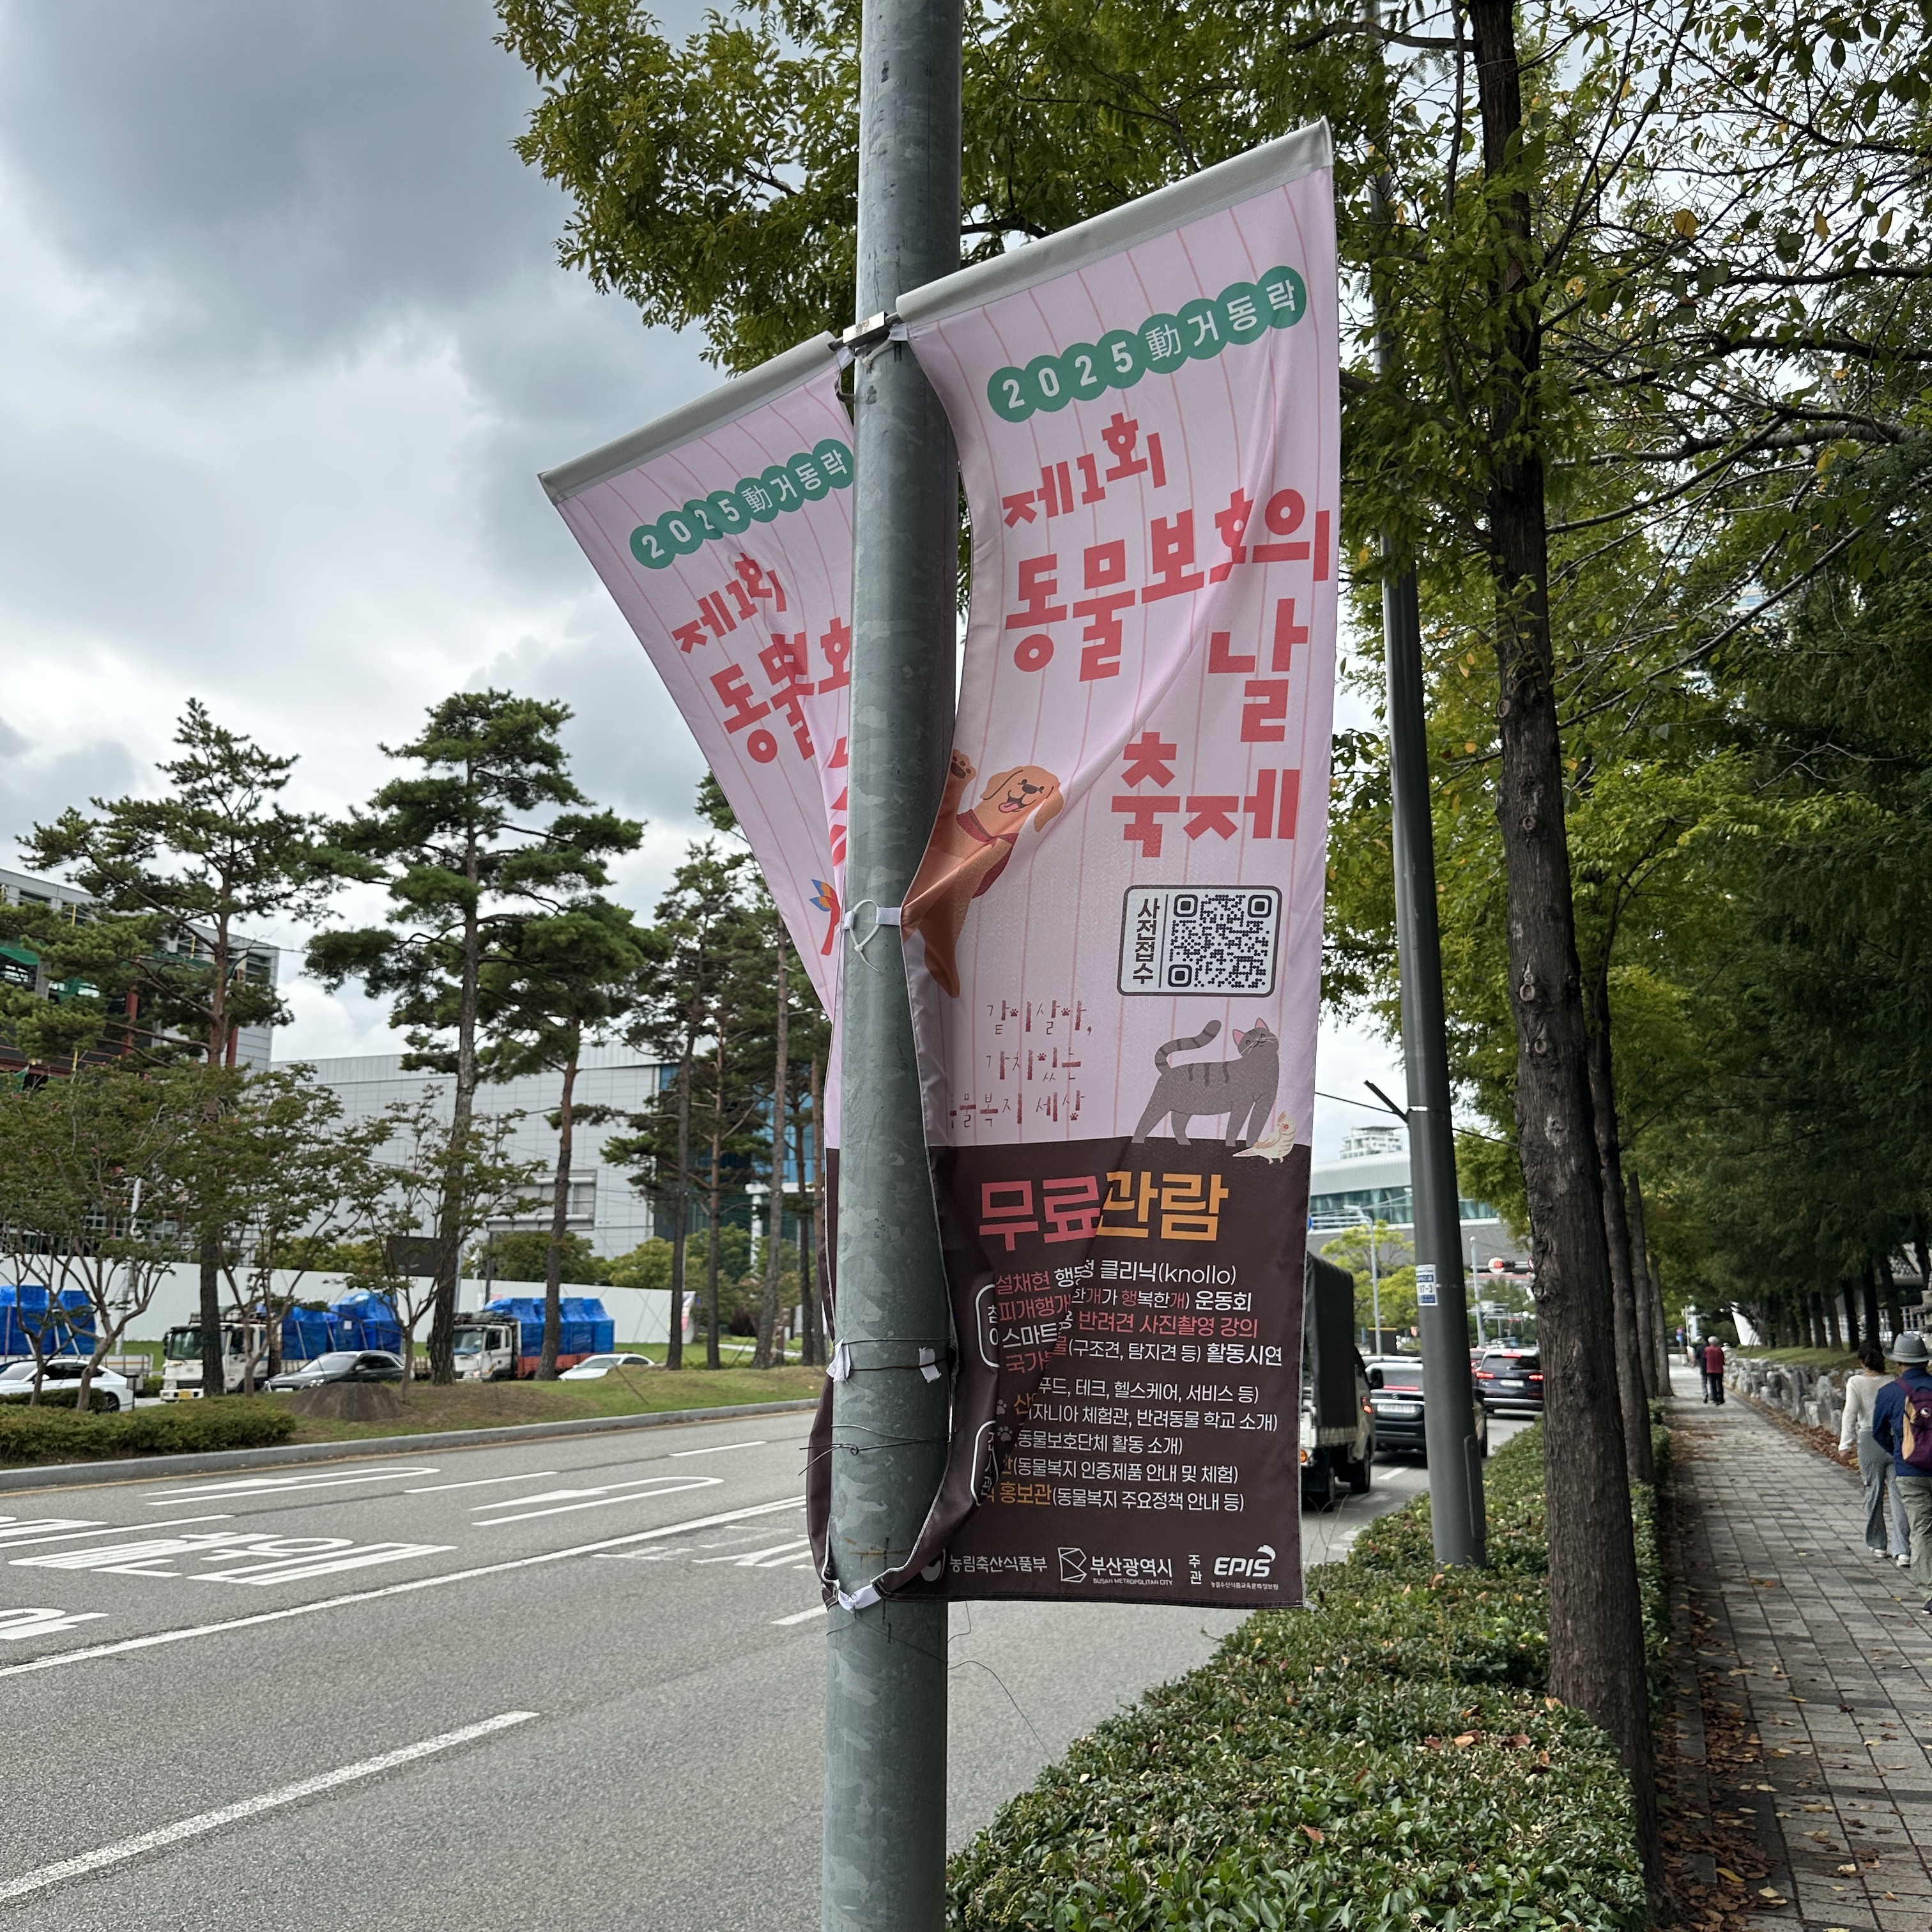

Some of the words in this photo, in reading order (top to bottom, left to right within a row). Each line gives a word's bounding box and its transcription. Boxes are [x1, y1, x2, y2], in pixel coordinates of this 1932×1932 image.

[1002, 413, 1167, 528] 제1회
[1006, 487, 1330, 682] 동물보호의
[1208, 598, 1308, 742] 날
[1111, 732, 1300, 858] 축제
[1133, 898, 1160, 984] 사전접수
[995, 1270, 1051, 1295] 설채현
[1100, 1259, 1237, 1285] 클리닉(knollo)
[1121, 1289, 1190, 1310] 행복한개)
[1195, 1289, 1252, 1312] 운동회
[1078, 1310, 1134, 1333] 반려견
[1138, 1314, 1215, 1337] 사진촬영
[1220, 1317, 1258, 1338] 강의
[1128, 1342, 1177, 1362] 탐지견
[1181, 1345, 1202, 1363] 등)
[1206, 1342, 1283, 1367] 활동시연
[1075, 1379, 1110, 1400] 테크,
[1114, 1380, 1183, 1403] 헬스케어,
[1186, 1384, 1234, 1402] 서비스
[1238, 1386, 1259, 1404] 등)
[1082, 1406, 1132, 1429] 체험관,
[1137, 1409, 1200, 1429] 반려동물
[1204, 1411, 1236, 1430] 학교
[1239, 1413, 1278, 1432] 소개)
[1015, 1429, 1108, 1453] 동물보호단체
[1112, 1434, 1144, 1453] 활동
[1147, 1436, 1183, 1455] 소개)
[1080, 1460, 1142, 1482] 인증제품
[1146, 1463, 1177, 1482] 안내
[1181, 1465, 1197, 1483] 및
[1200, 1464, 1239, 1484] 체험)
[1121, 1491, 1183, 1510] 주요정책
[1187, 1492, 1220, 1511] 안내
[1223, 1493, 1245, 1512] 등)
[949, 1554, 1048, 1573] 농림축산식품부
[1090, 1556, 1173, 1578] 부산광역시
[1188, 1554, 1202, 1584] 주관
[1213, 1556, 1271, 1577] EPIS
